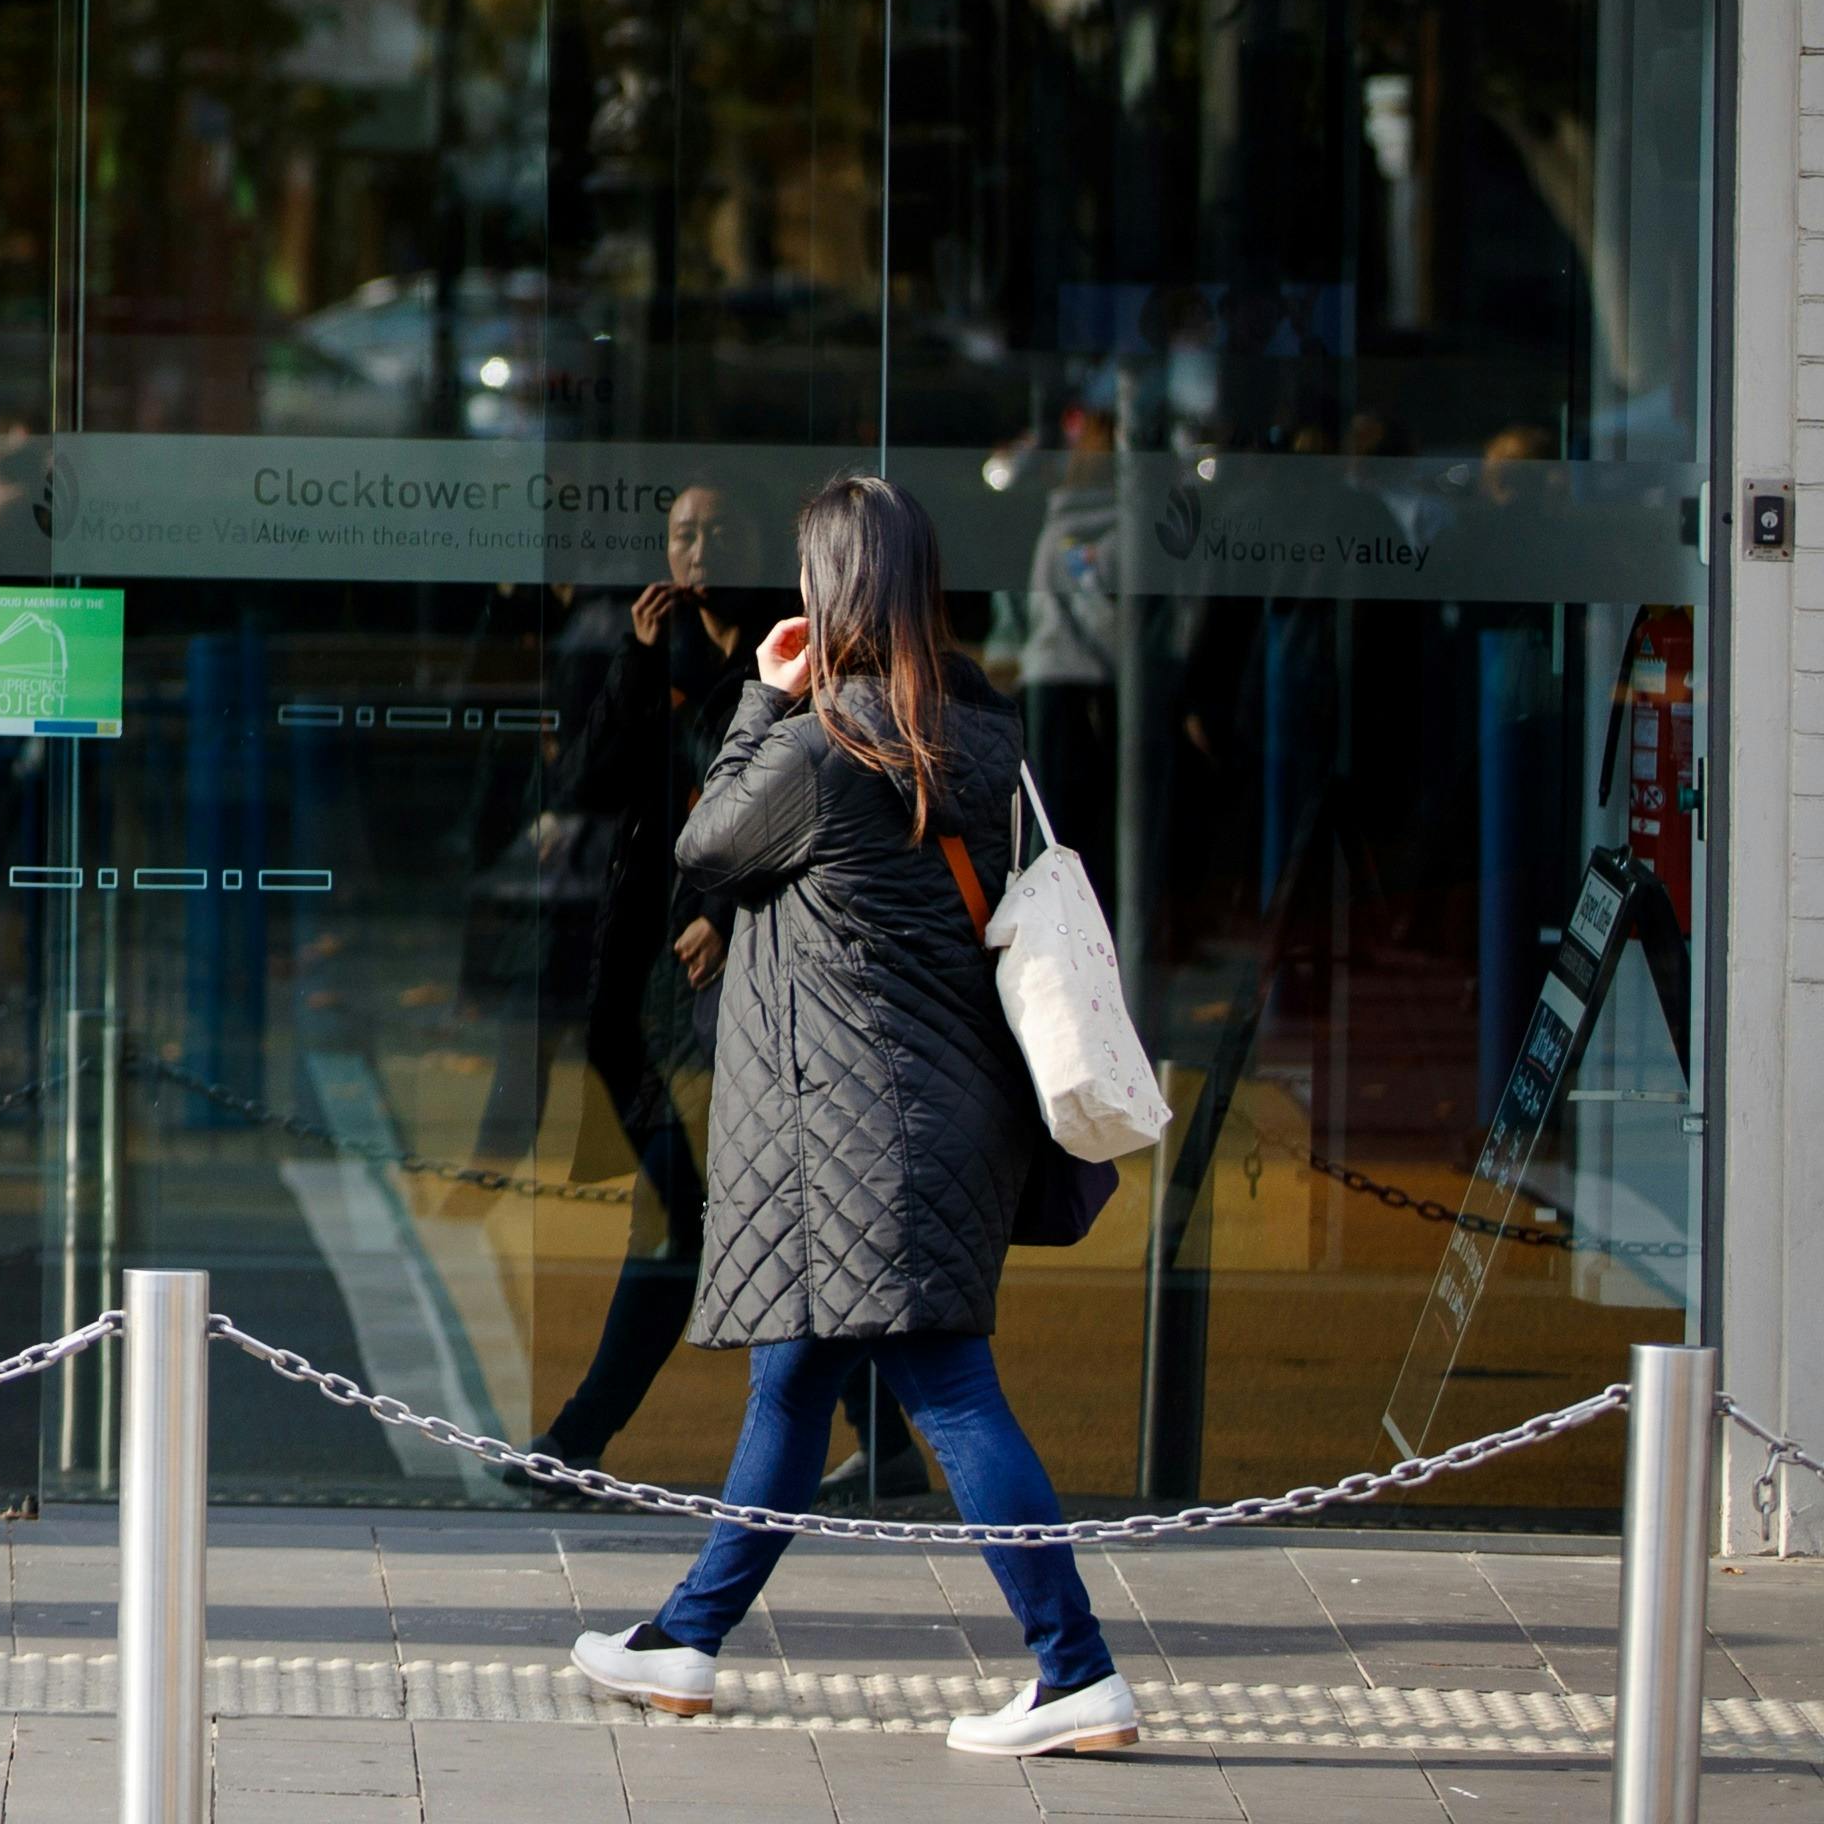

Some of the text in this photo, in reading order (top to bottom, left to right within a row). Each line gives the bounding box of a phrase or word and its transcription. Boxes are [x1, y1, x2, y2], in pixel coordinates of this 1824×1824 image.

[253, 466, 678, 514] Clocktower Centre
[81, 516, 203, 544] Moonee
[256, 523, 310, 546] Alive
[317, 525, 364, 547] with
[372, 526, 460, 550] theatre,
[467, 527, 572, 550] functions
[580, 530, 598, 550] &
[1203, 534, 1431, 573] Moonee Valley
[24, 596, 67, 608] MEMBER
[85, 598, 104, 609] THE
